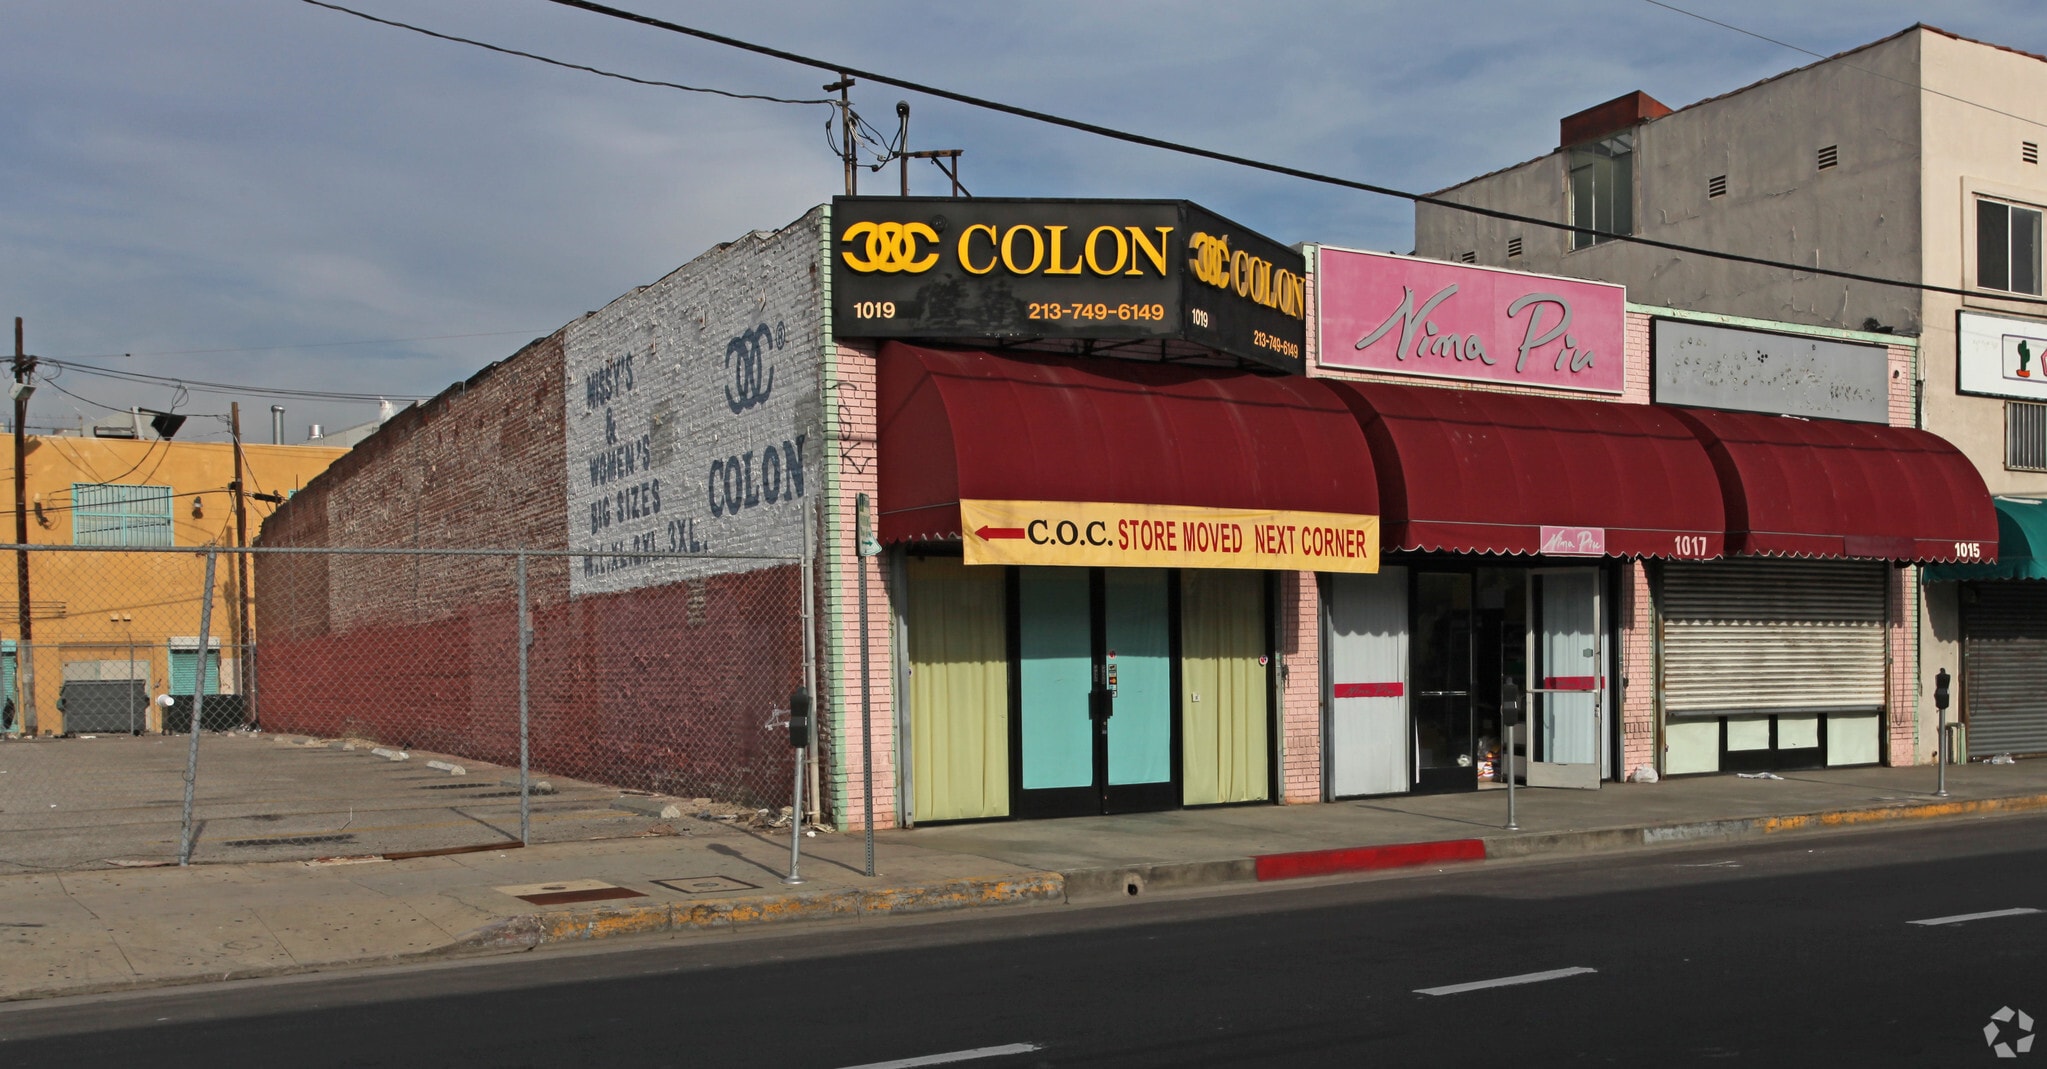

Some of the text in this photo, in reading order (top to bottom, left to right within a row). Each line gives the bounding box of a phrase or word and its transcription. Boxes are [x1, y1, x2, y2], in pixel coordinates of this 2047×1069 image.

[957, 223, 1174, 277] COLON
[1229, 249, 1306, 320] COLON
[854, 302, 1164, 321] 1019 213-749-6149
[1192, 307, 1299, 359] 1019 213-749-6149
[1355, 284, 1594, 373] Nina Piu
[606, 407, 617, 445] &
[590, 433, 650, 488] WOMEN'S
[709, 434, 806, 518] COLON
[591, 478, 661, 535] BIG SIZES
[1027, 518, 1367, 558] C.O.C. STORE MOVED NEXT CORNER
[1542, 529, 1601, 552] Nina Piu
[1674, 535, 1707, 556] 1017
[1954, 542, 1980, 558] 1015
